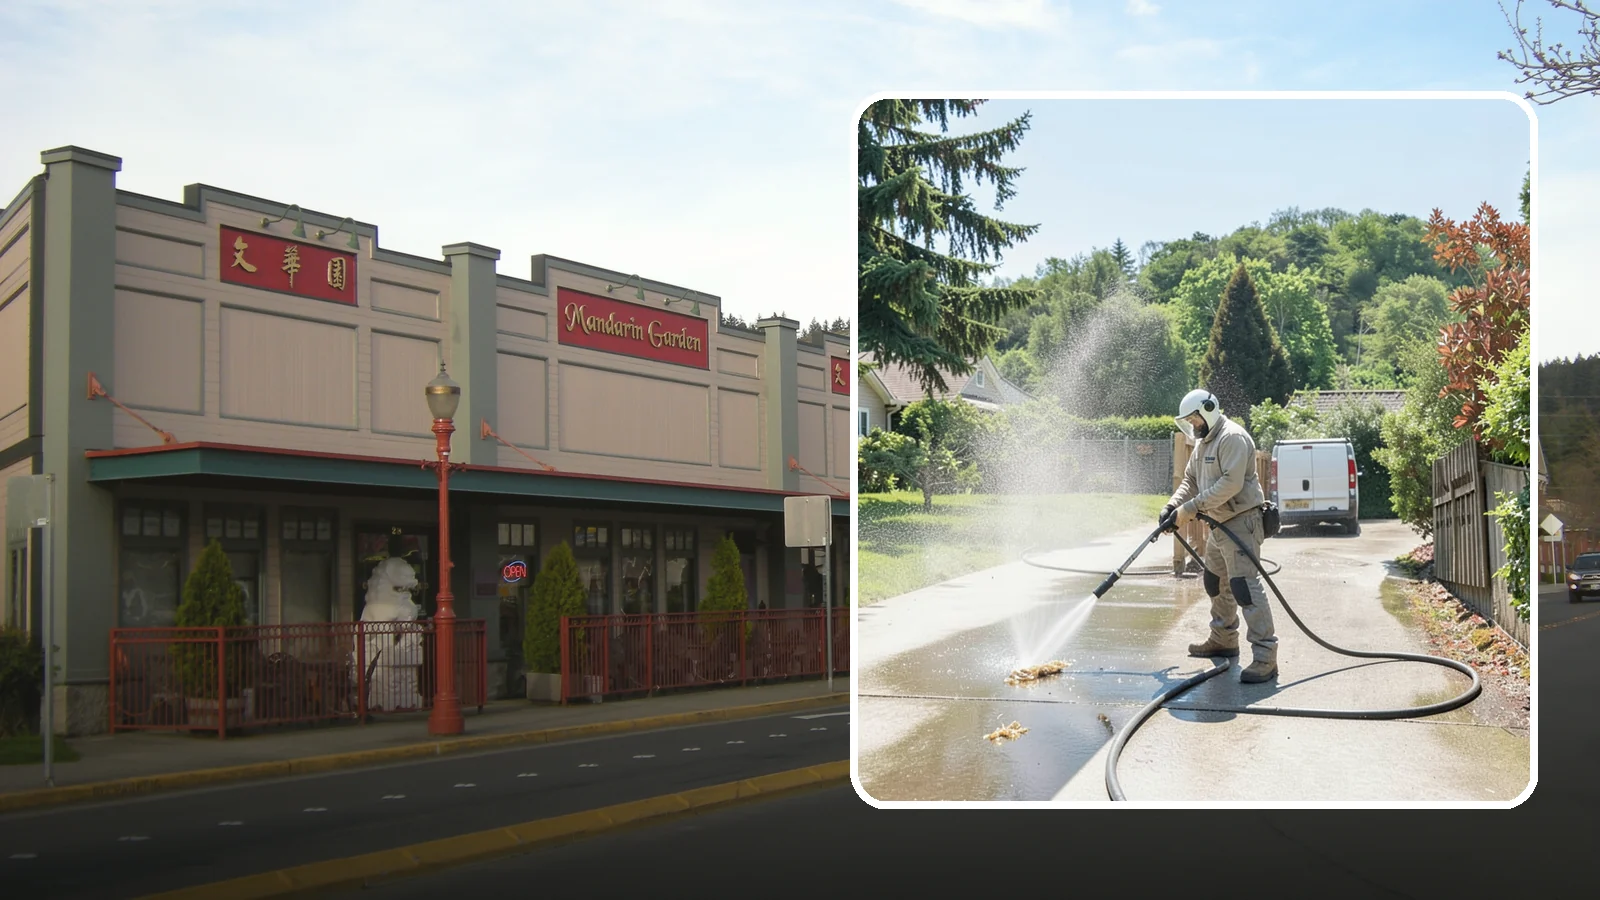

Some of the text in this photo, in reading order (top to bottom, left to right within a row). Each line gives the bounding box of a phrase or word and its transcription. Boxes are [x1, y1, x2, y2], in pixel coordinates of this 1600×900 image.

[565, 302, 701, 352] Mandarin Garden
[503, 565, 527, 578] OPEN
